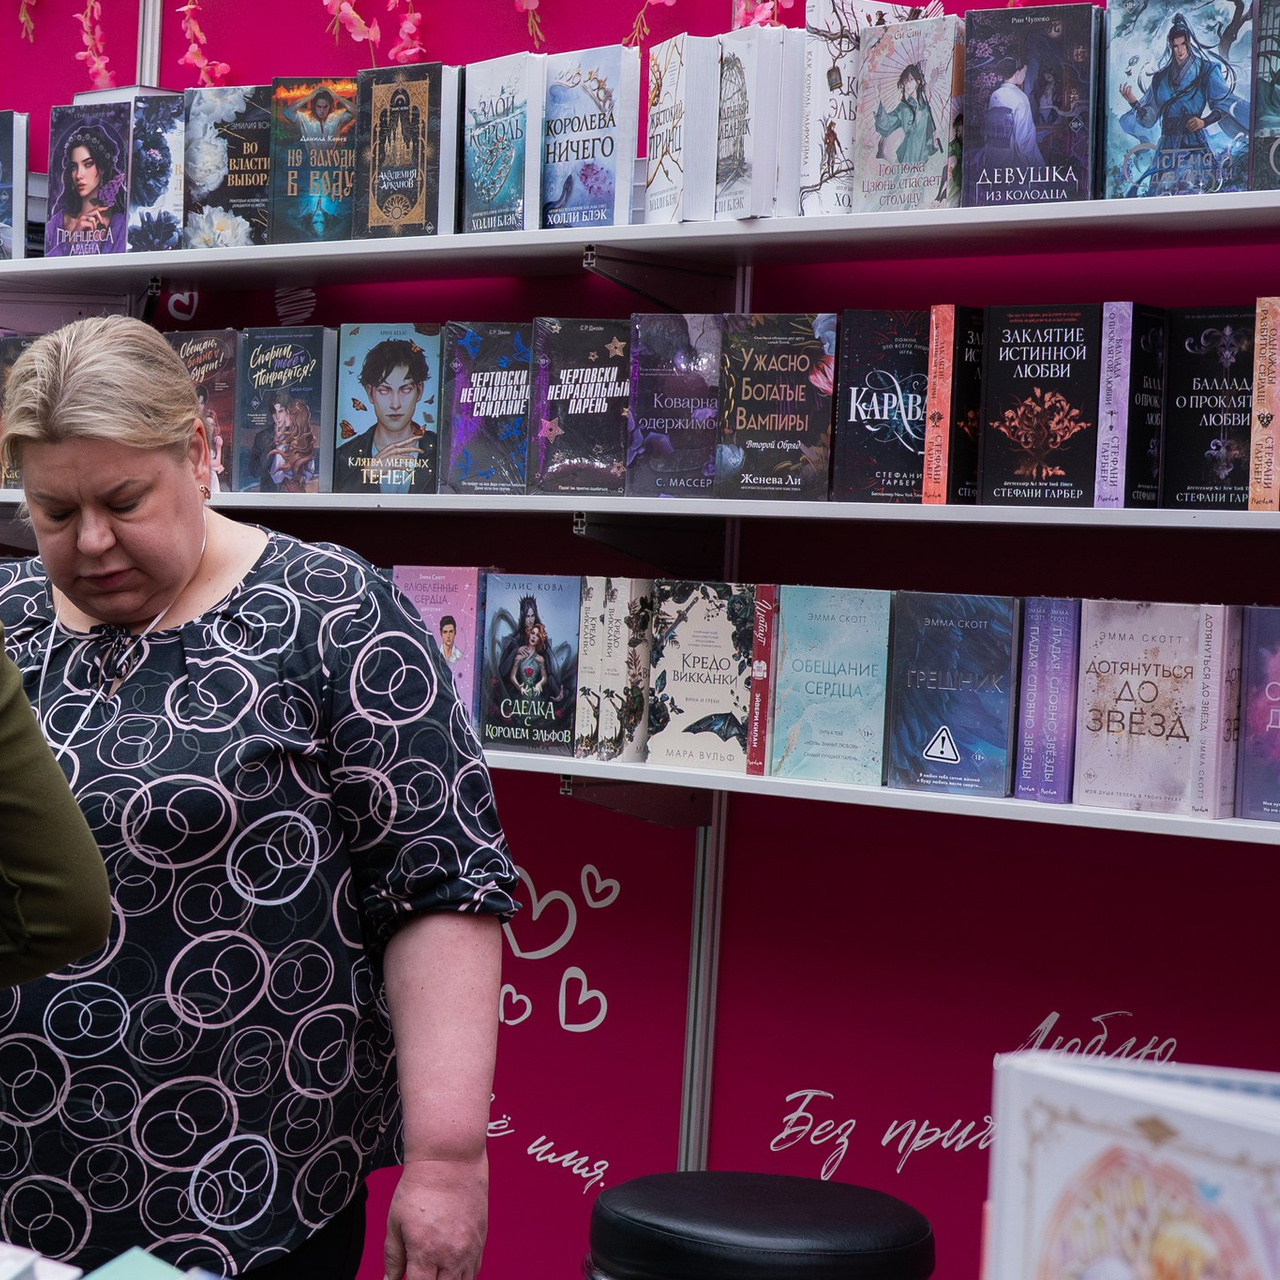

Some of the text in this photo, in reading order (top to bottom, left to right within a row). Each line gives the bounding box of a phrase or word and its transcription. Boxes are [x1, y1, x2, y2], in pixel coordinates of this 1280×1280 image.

[1011, 15, 1050, 24] Рин Чупеко
[480, 94, 514, 118] ЗЛОЙ
[230, 122, 257, 130] ЭМИЛИЯ
[545, 111, 616, 137] КОРОЛЕВА
[300, 134, 326, 142] Данила
[470, 118, 524, 149] КОРОЛЬ
[243, 141, 258, 154] ВО
[546, 136, 614, 164] НИЧЕГО
[649, 125, 682, 161] ПРИНЦ
[287, 148, 356, 170] НЕ ЗАХОДИ
[879, 159, 926, 177] Госпожа
[378, 169, 417, 181] АКАДЕМИЯ
[862, 173, 942, 193] Цзюнь спасает
[975, 165, 1078, 186] ДЕВУШКА
[287, 170, 355, 202] В ВОДУ
[380, 179, 414, 191] АРКАНОВ
[879, 190, 923, 206] столицу
[986, 188, 1068, 202] ИЗ КОЛОДЦА
[471, 214, 496, 231] ХОЛЛИ
[547, 209, 607, 225] ХОЛЛИ БЛЭК
[56, 228, 114, 245] ПРИНЦЕССА
[70, 243, 100, 256] АРДЕНА
[1001, 327, 1084, 343] ЗАКЛЯТИЕ
[250, 344, 292, 368] Спорим
[999, 345, 1086, 361] ИСТИННОЙ
[1257, 309, 1268, 405] РАЗБИТОЕ СЕРДЦЕ
[1267, 328, 1277, 385] ОДНАЖДЫ
[470, 371, 527, 387] ЧЕРТОВСКИ
[559, 367, 619, 385] ЧЕРТОВСКИ
[1013, 363, 1071, 378] ЛЮБВИ
[547, 379, 630, 401] НЕПРАВИЛЬНЫЙ
[473, 400, 526, 418] СВИДАНИЕ
[568, 398, 608, 415] ПАРЕНЬ
[1176, 395, 1187, 409] О
[1199, 412, 1250, 427] ЛЮБВИ
[746, 440, 802, 453] Второй Обряд
[348, 456, 430, 469] КЛЯТВА МЕРТВЫХ
[1100, 442, 1109, 483] ГАРБЕР
[1110, 435, 1120, 488] СТЕФАНИ
[1253, 442, 1262, 484] ГАРБЕР
[1264, 435, 1275, 489] СТЕФАНИ
[361, 468, 417, 486] ТЕНЕЙ
[656, 478, 713, 488] С. МАССЕР
[740, 474, 801, 486] Женева Ли
[875, 471, 923, 480] СТЕФАНИ
[993, 488, 1084, 499] СТЕФАНИ ГАРБЕР
[1176, 491, 1226, 503] СТЕФАНИ
[505, 581, 564, 592] ЭЛИС КОВА
[414, 594, 449, 605] СЕРДЦА
[807, 613, 868, 624] ЭММА СКОТТ
[924, 618, 989, 630] ЭММА СКОТТ
[582, 606, 590, 656] ВИККАНКИ
[607, 608, 615, 658] ВИККАНКИ
[1099, 632, 1183, 644] ЭММА СКОТТ
[1201, 613, 1213, 681] ДОТЯНУТЬСЯ
[682, 652, 731, 673] КРЕДО
[791, 658, 880, 679] ОБЕЩАНИЕ
[1086, 660, 1194, 680] ДОТЯНУТЬСЯ
[672, 670, 738, 688] ВИККАНКИ
[907, 670, 1005, 694] ГРЕШНИК
[804, 681, 864, 699] СЕРДЦА
[1115, 680, 1159, 704] ДО
[1201, 682, 1210, 698] ДО
[501, 698, 556, 720] СДЕЛКА
[485, 724, 571, 743] КОРОЛЕМ ЭЛЬФОВ
[1022, 675, 1038, 779] СЛОВНО ЗВЁЗДЫ
[1044, 676, 1060, 783] СЛОВНО ЗВЁЗДЫ
[1086, 707, 1190, 743] ЗВЁЗД
[665, 749, 735, 762] МАРА ВУЛЬФ
[1197, 770, 1205, 801] СКОТТ
[770, 1088, 856, 1180] Без
